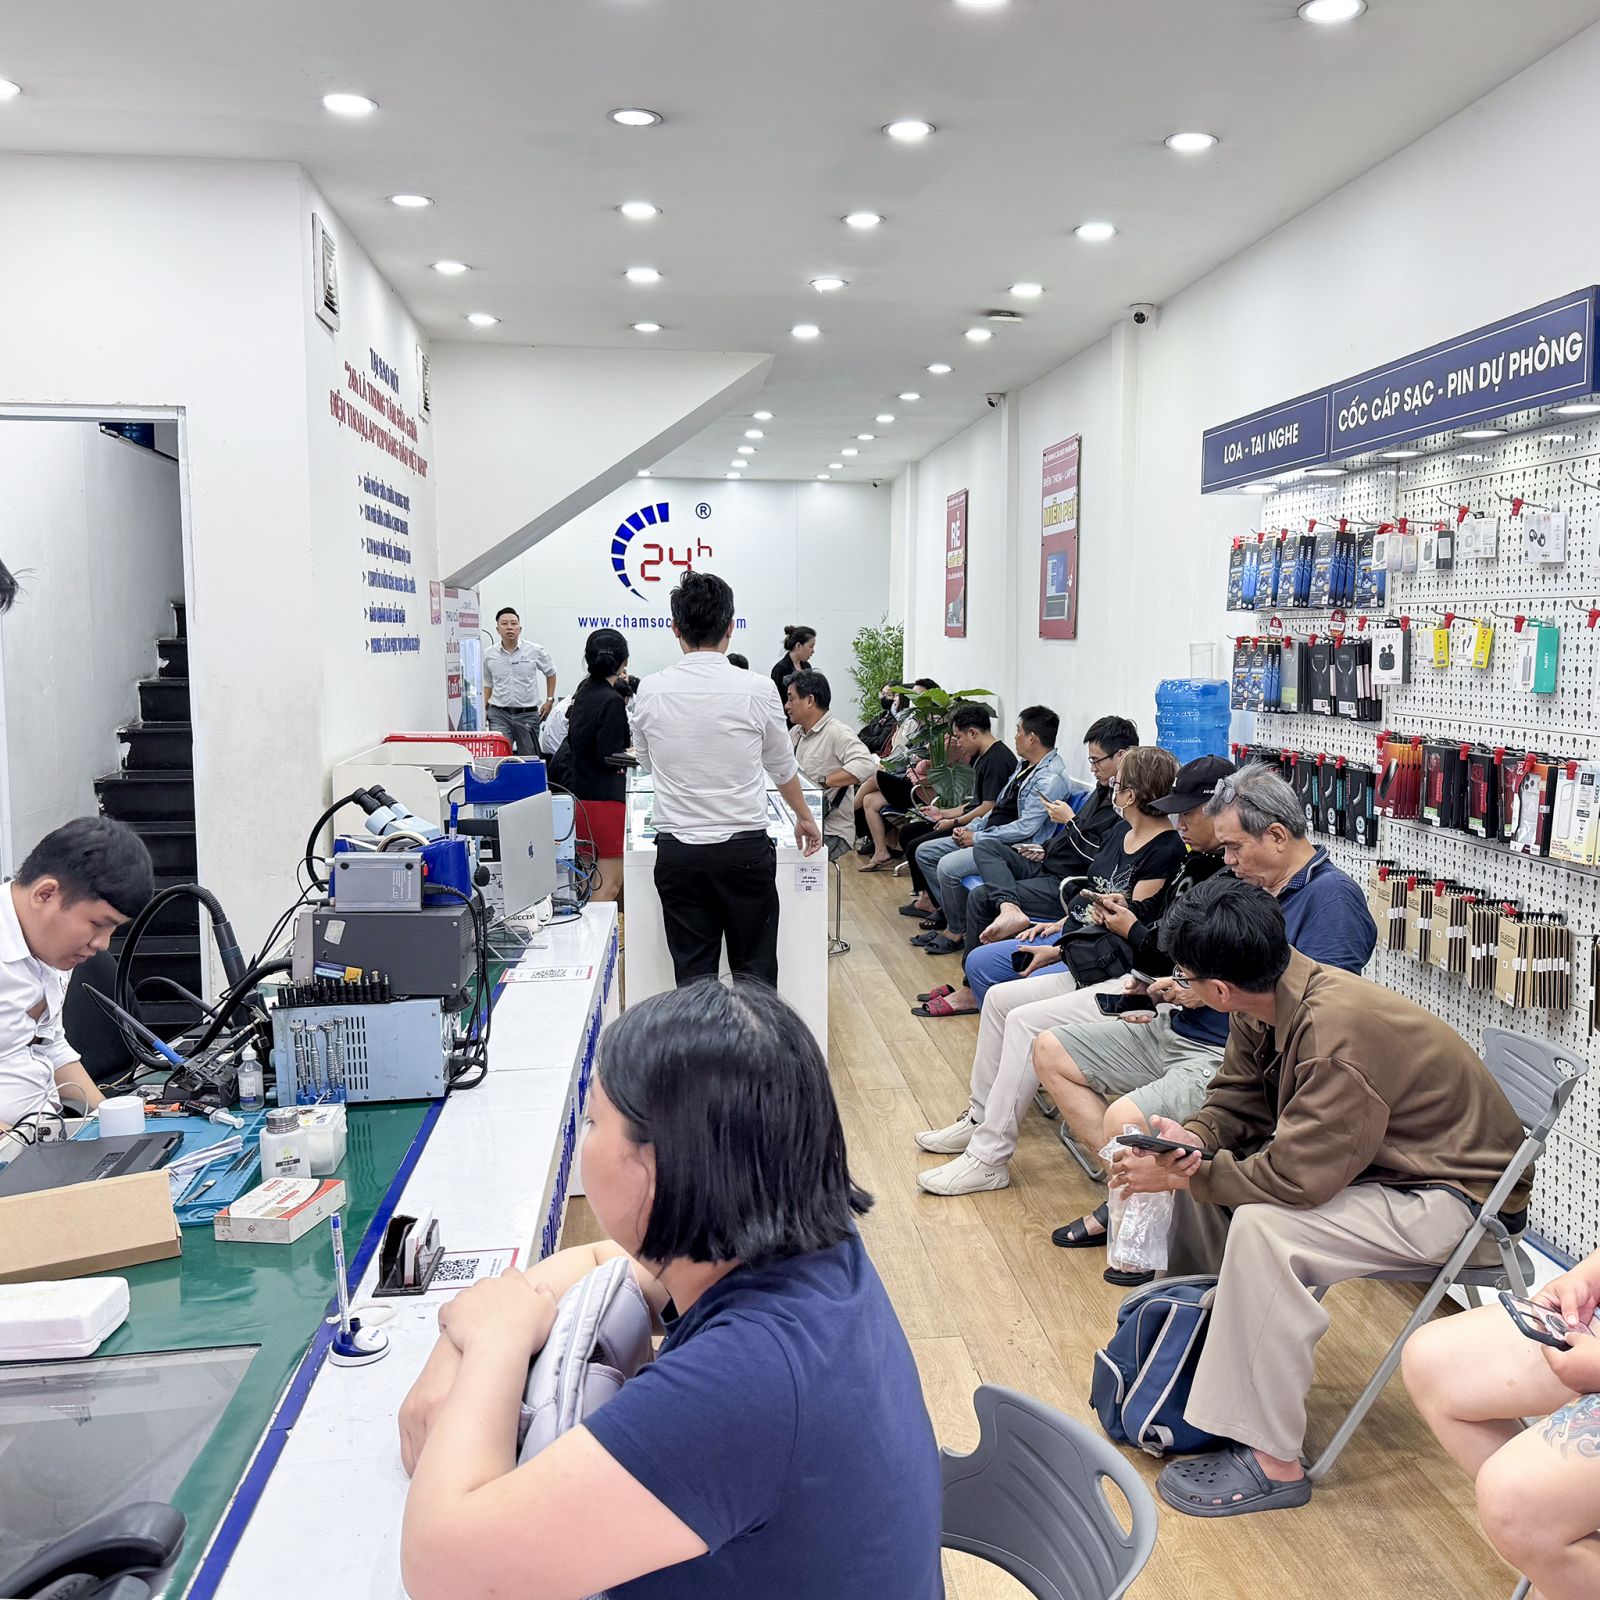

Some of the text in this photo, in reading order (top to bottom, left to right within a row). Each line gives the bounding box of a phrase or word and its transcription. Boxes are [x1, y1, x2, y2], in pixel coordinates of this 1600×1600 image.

[1338, 394, 1368, 432] CỐC
[1372, 387, 1400, 421] CÁP
[1403, 380, 1434, 416] SẠC
[1447, 366, 1474, 398] PIN
[1479, 352, 1504, 392] DỰ
[1508, 331, 1583, 380] PHÒNG
[1224, 441, 1243, 464] LOA
[1251, 433, 1266, 456] TAI
[1268, 422, 1299, 451] NGHE
[1043, 496, 1062, 528] MIỄN
[1375, 632, 1398, 640] HAVIT
